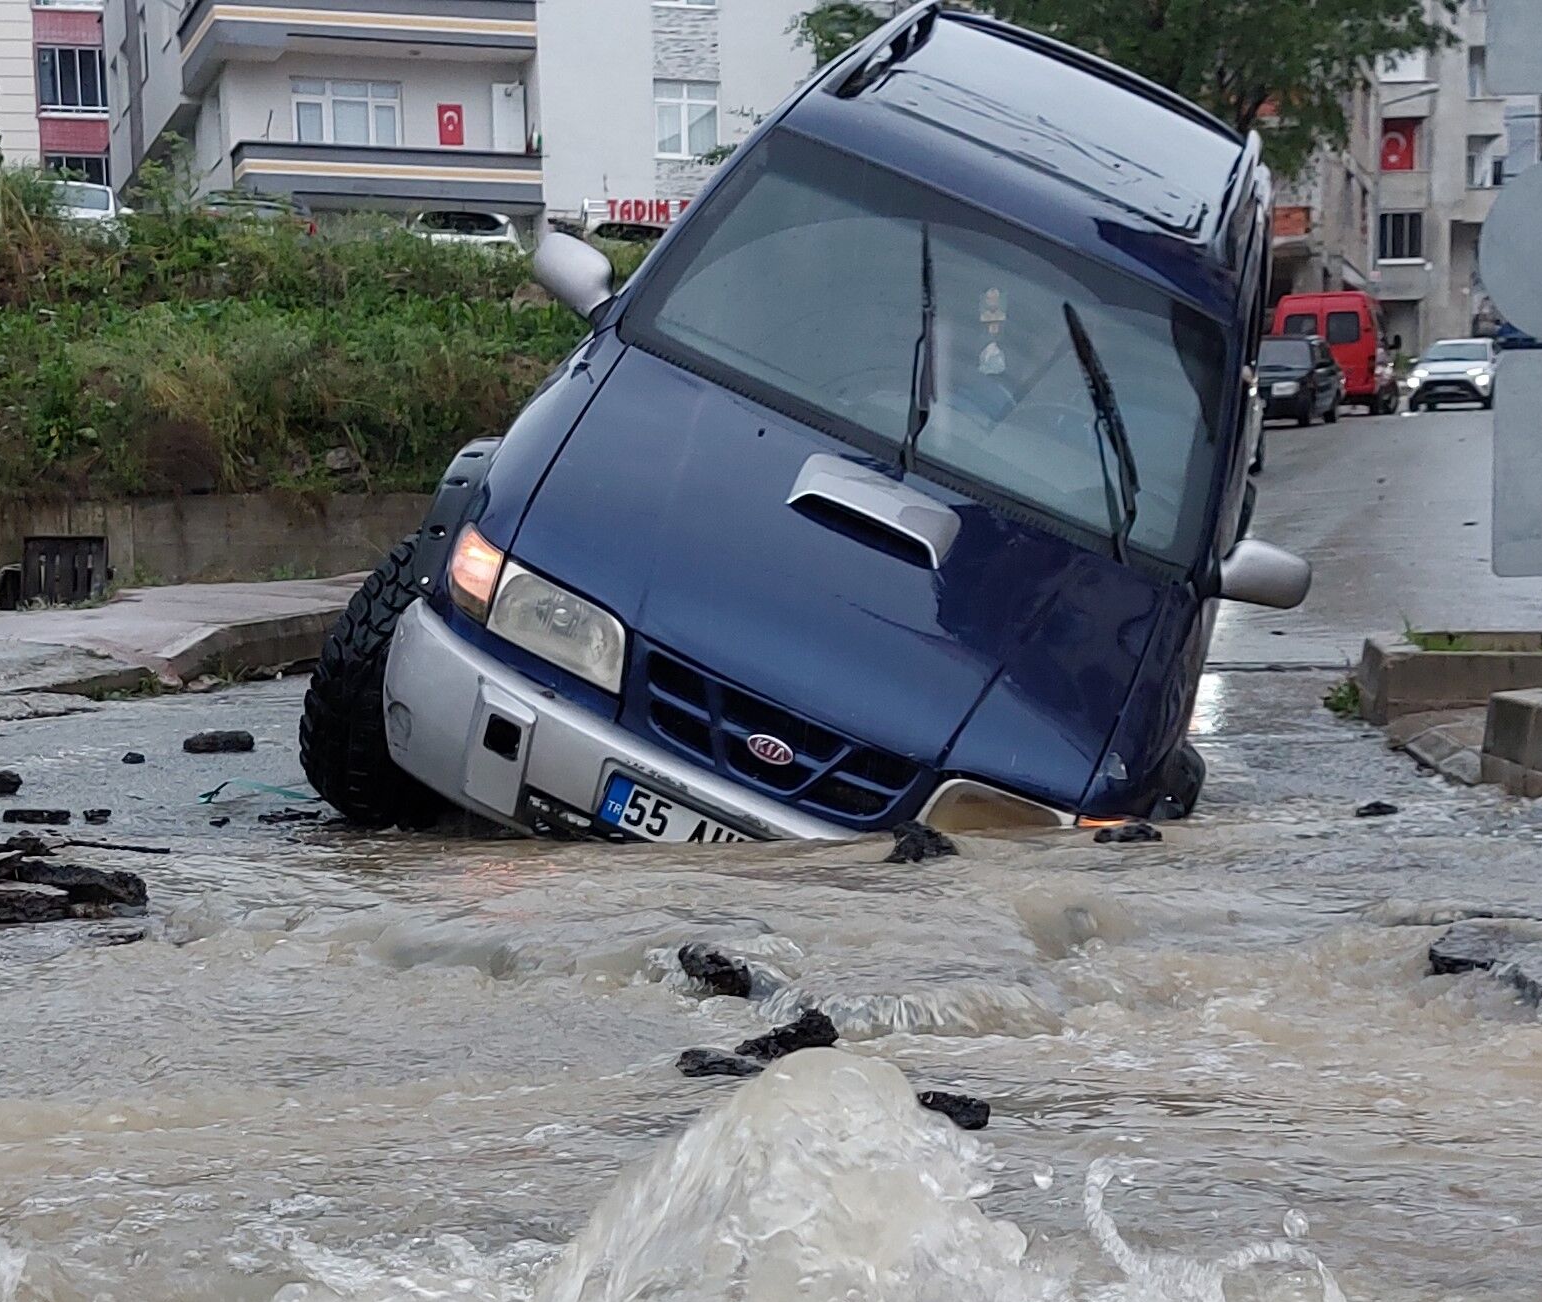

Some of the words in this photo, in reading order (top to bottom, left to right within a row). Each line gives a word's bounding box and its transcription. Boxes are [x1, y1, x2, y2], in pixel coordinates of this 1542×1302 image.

[607, 199, 670, 223] TADIM
[754, 738, 785, 760] KIA
[607, 801, 622, 814] TR
[624, 790, 672, 836] 55
